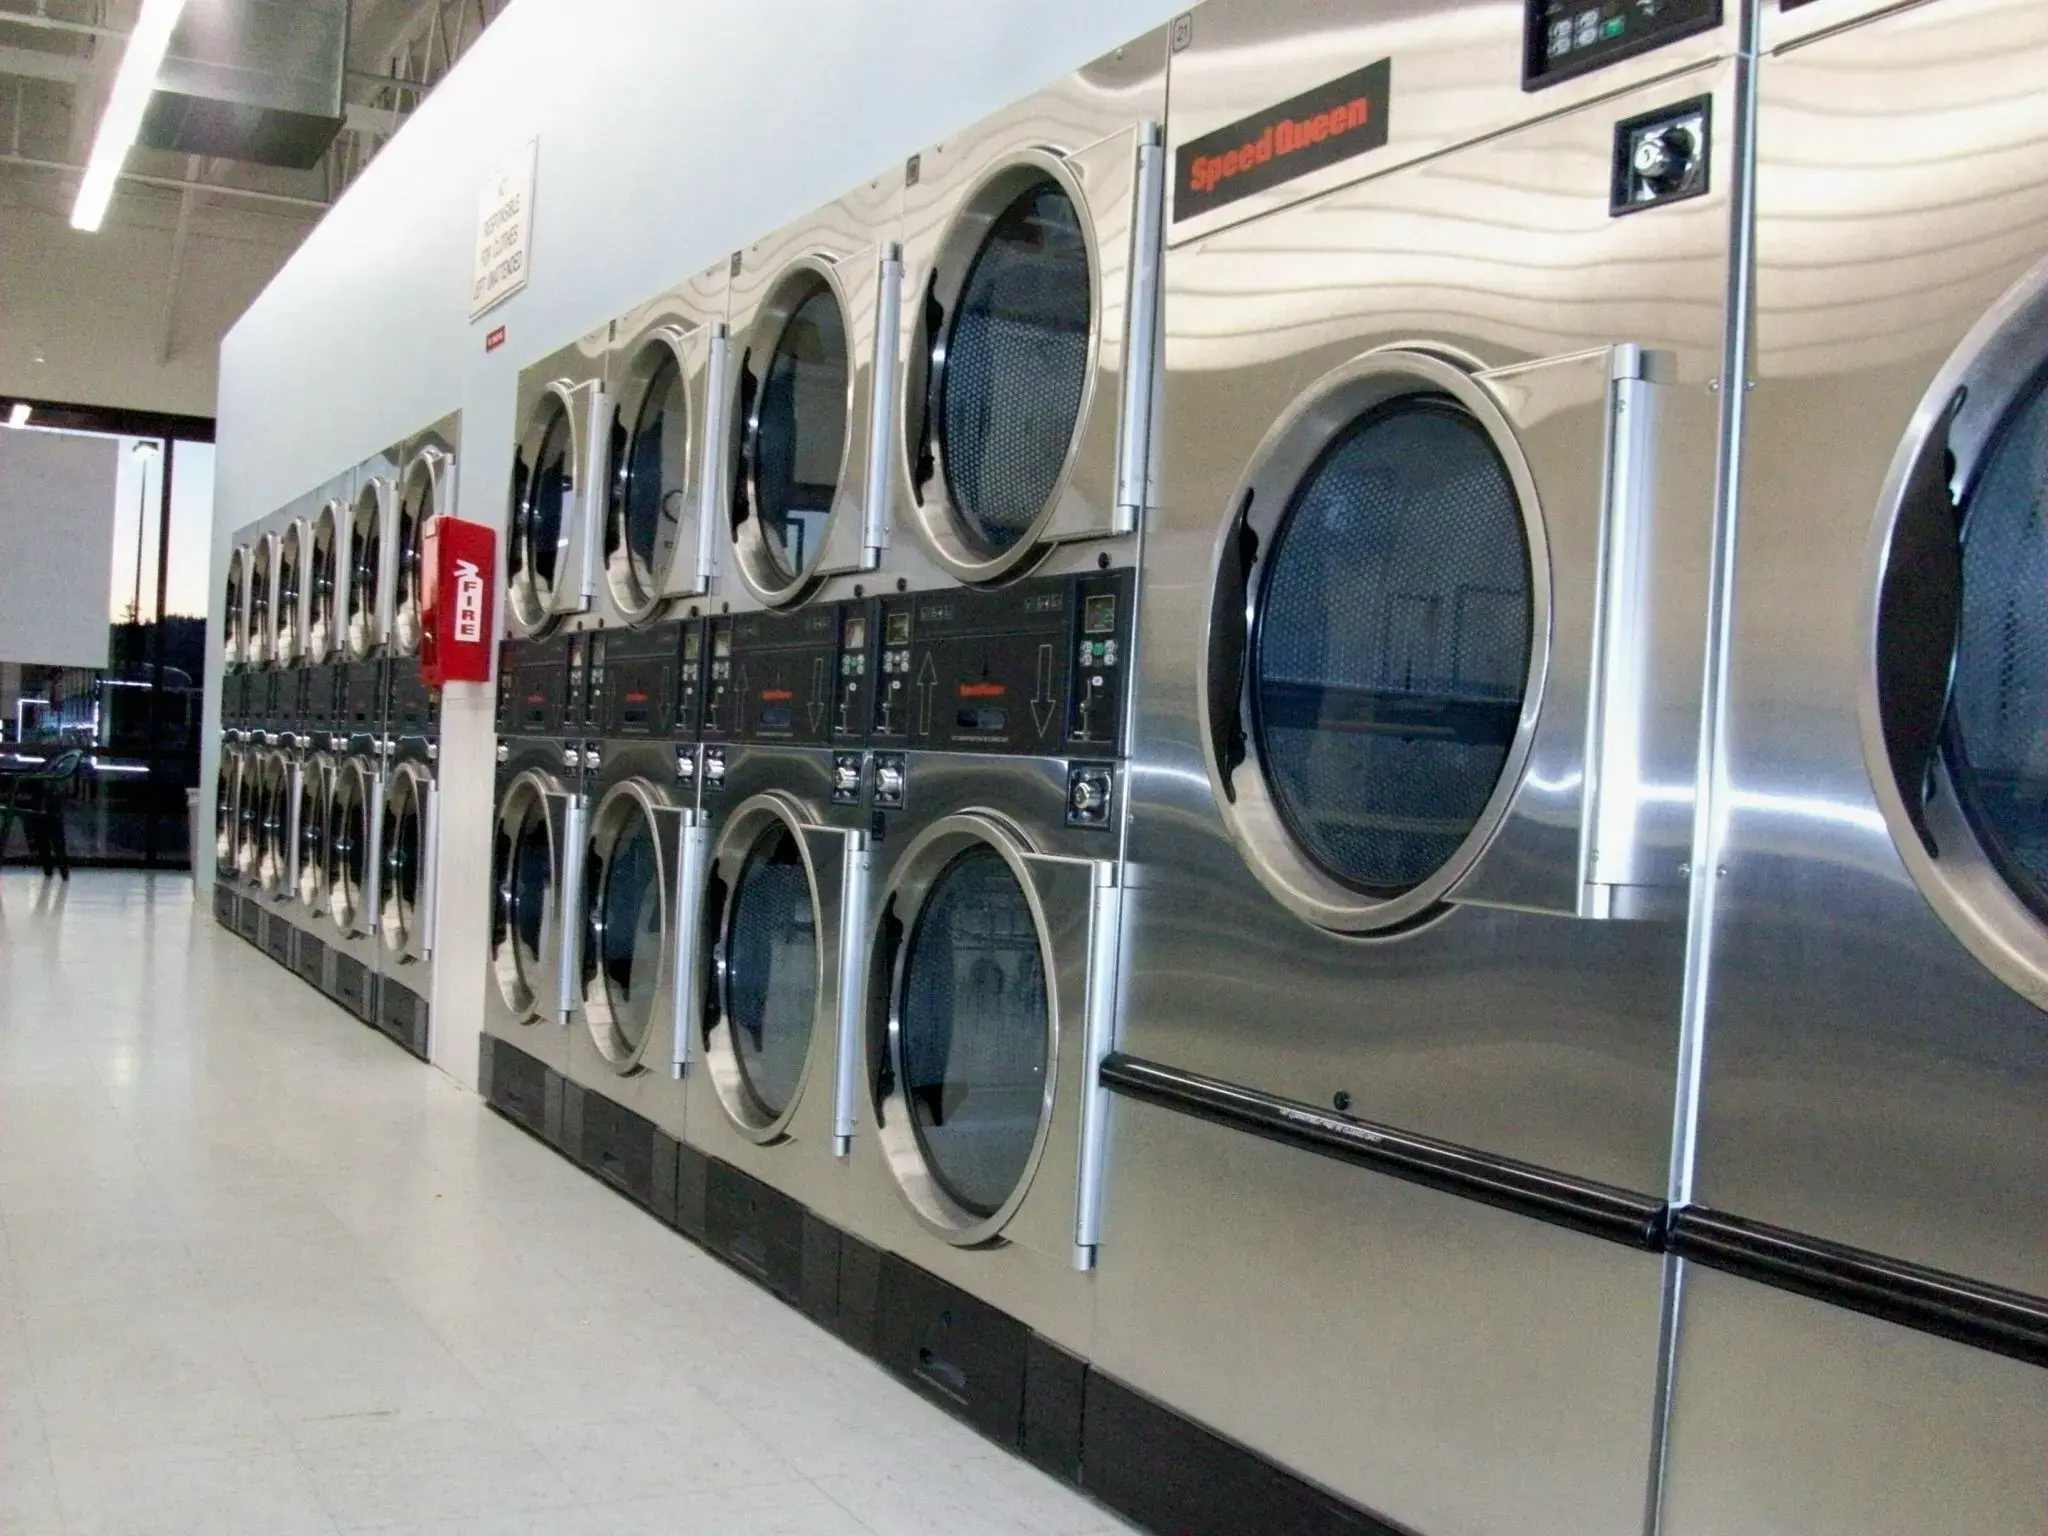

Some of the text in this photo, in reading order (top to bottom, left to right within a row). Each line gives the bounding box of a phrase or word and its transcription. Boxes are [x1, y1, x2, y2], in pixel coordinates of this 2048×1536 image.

[1190, 97, 1368, 192] Speed Queen
[461, 581, 477, 635] FIRE
